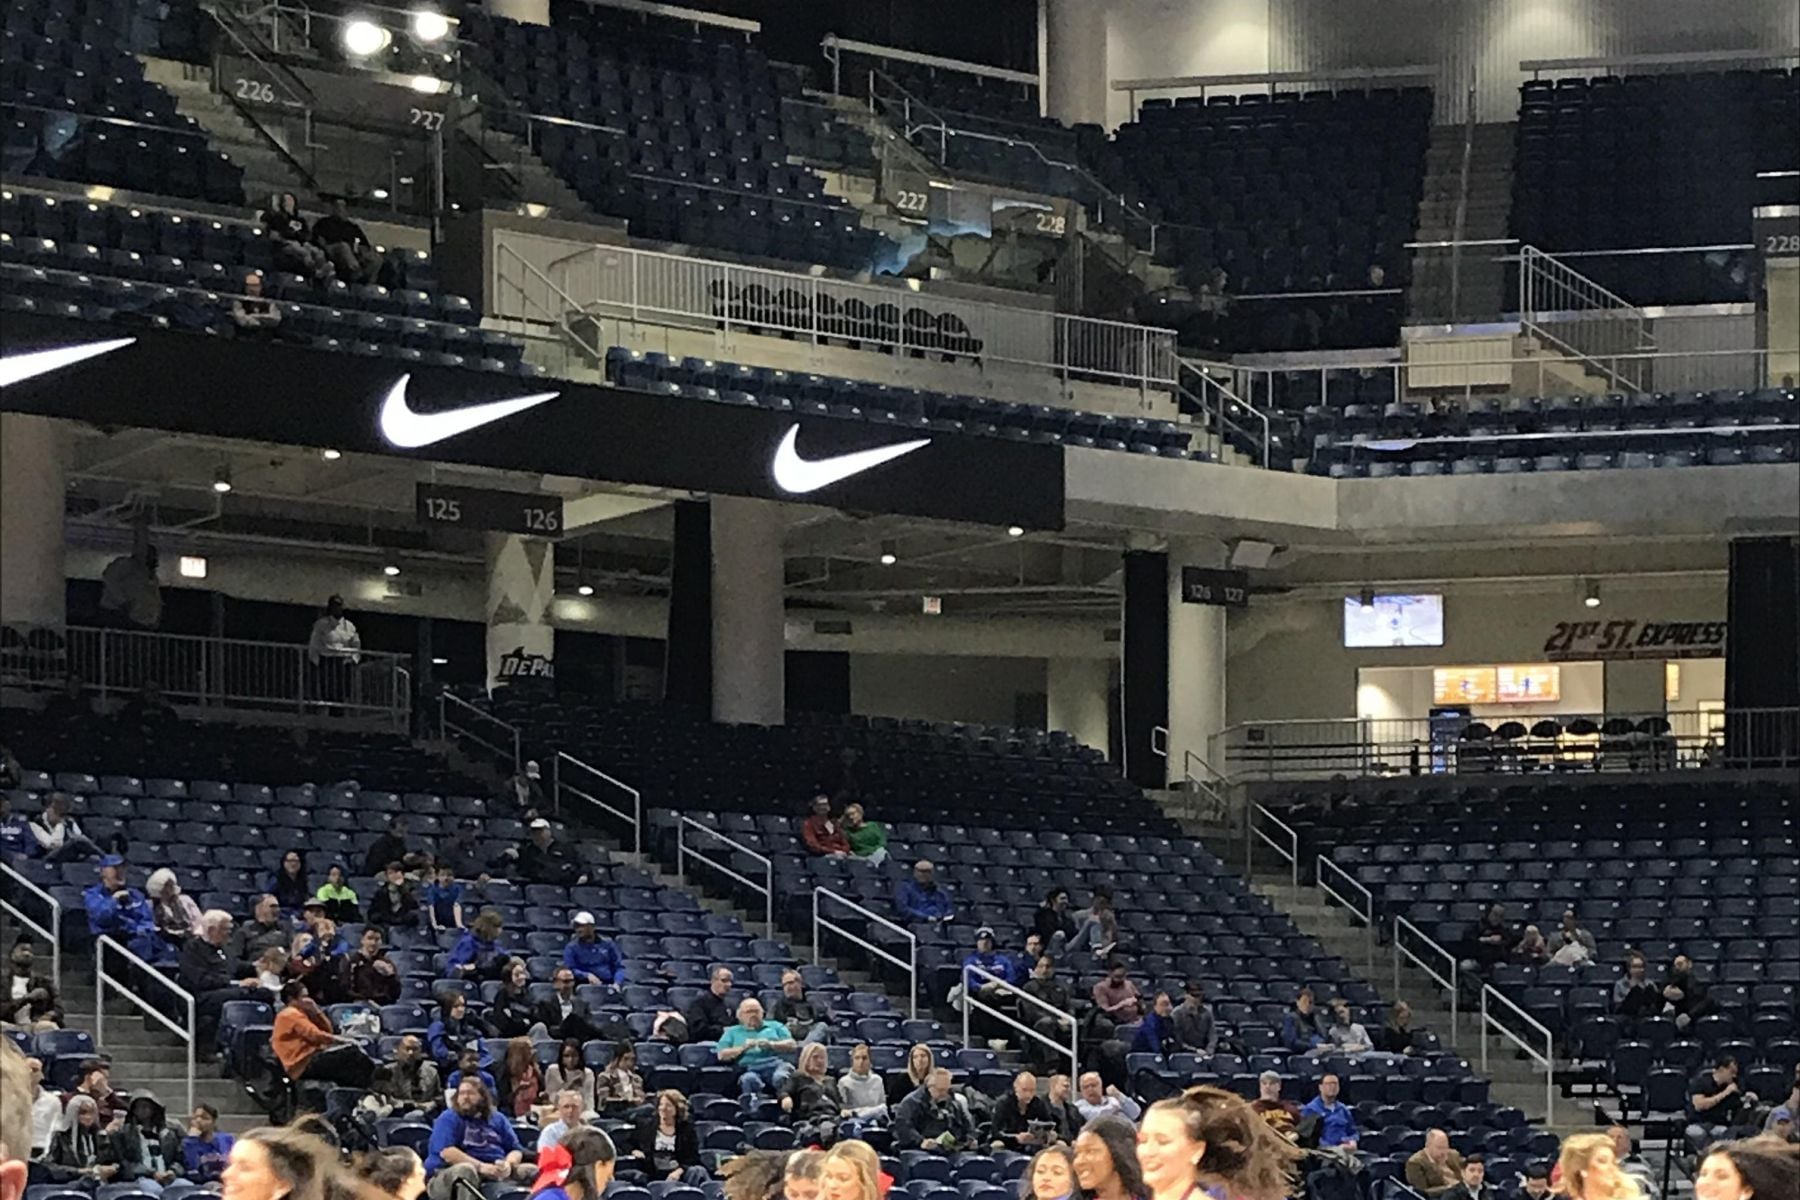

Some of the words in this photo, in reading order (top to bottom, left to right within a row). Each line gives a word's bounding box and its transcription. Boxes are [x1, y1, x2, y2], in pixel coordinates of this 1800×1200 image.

[236, 79, 275, 102] 226
[897, 190, 928, 211] 227
[1036, 213, 1066, 234] 228
[1767, 235, 1800, 252] 228
[426, 498, 461, 521] 125
[523, 508, 558, 531] 126
[1224, 587, 1244, 602] 127
[1635, 621, 1728, 647] EXPRESS
